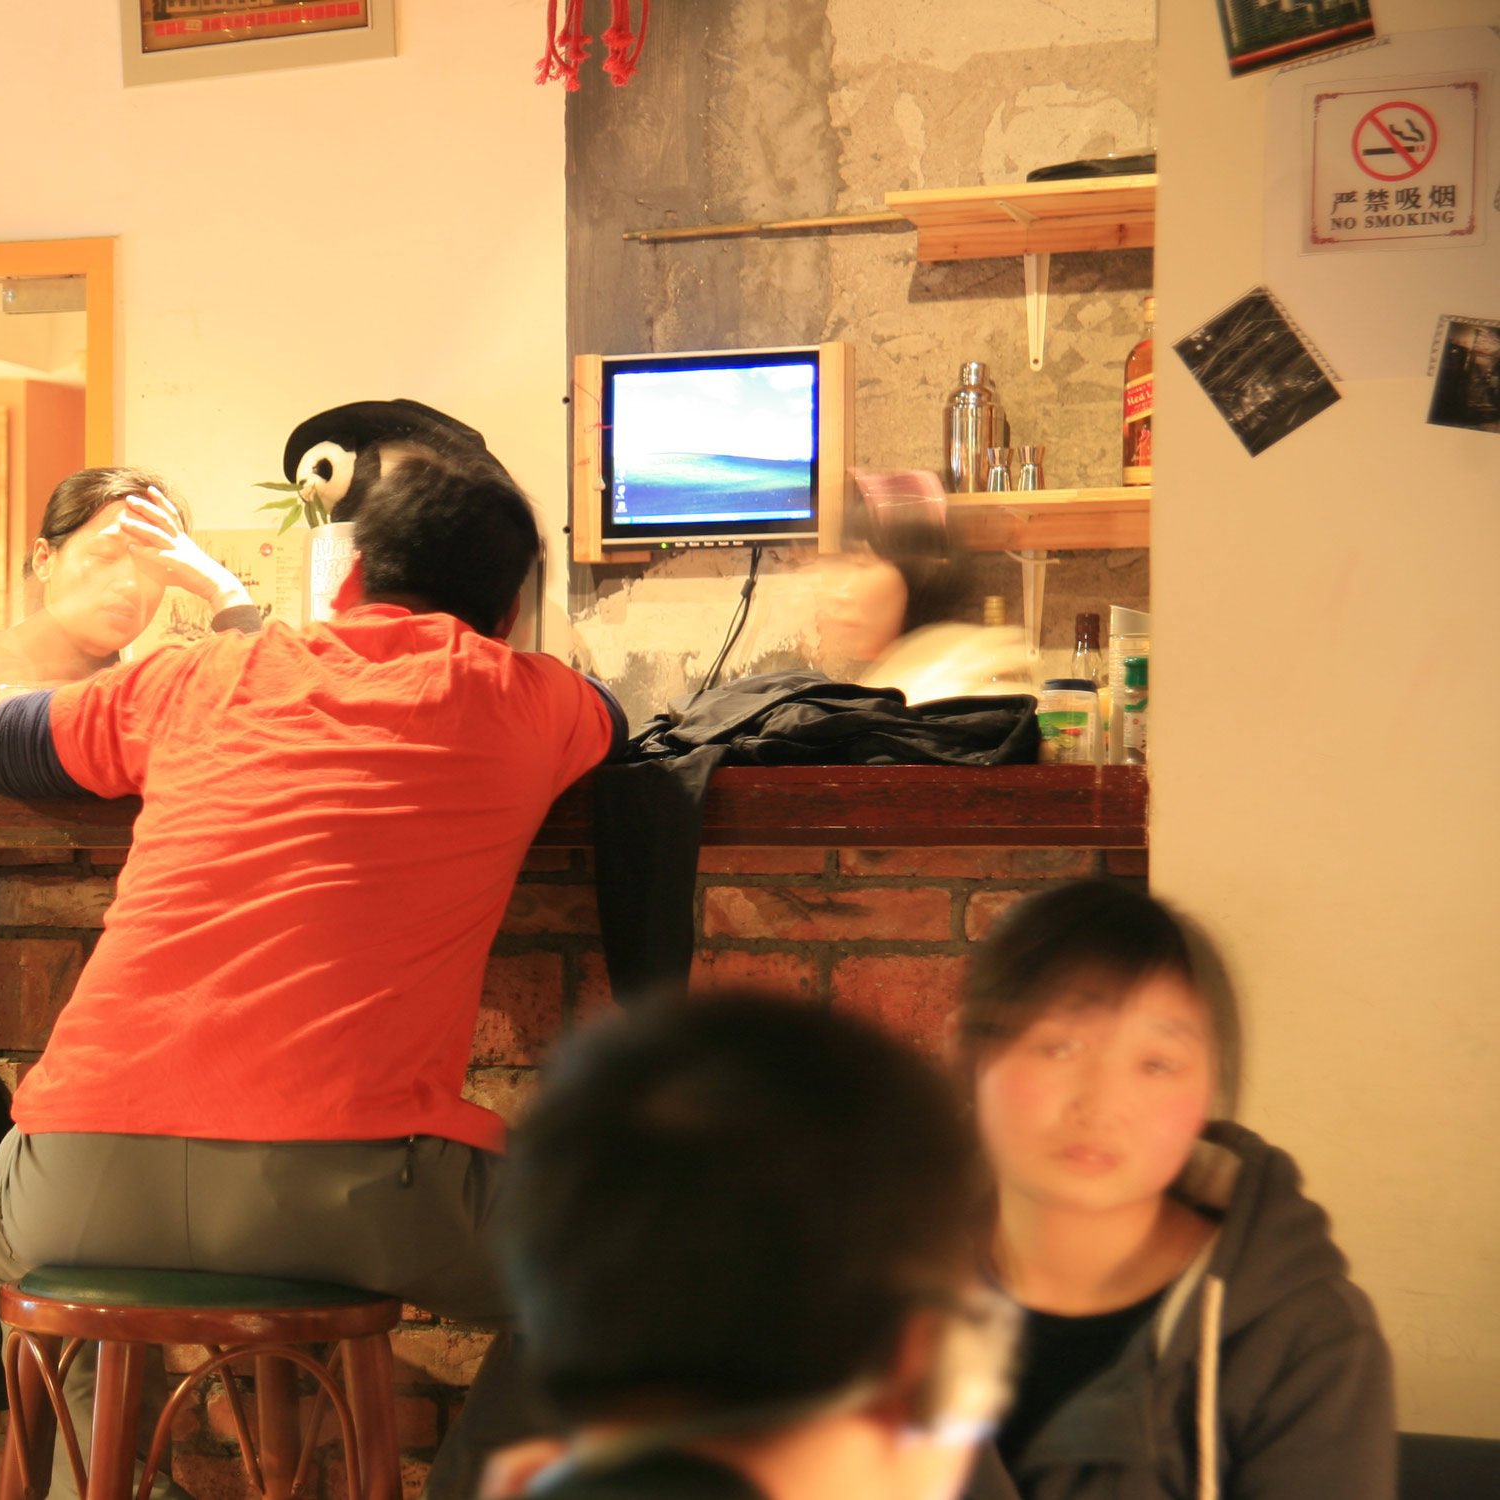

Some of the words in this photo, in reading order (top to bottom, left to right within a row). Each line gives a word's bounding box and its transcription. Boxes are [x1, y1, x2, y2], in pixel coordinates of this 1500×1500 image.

[1330, 185, 1456, 215] 严禁吸烟
[1330, 217, 1356, 230] NO
[1364, 210, 1454, 228] SMOKING
